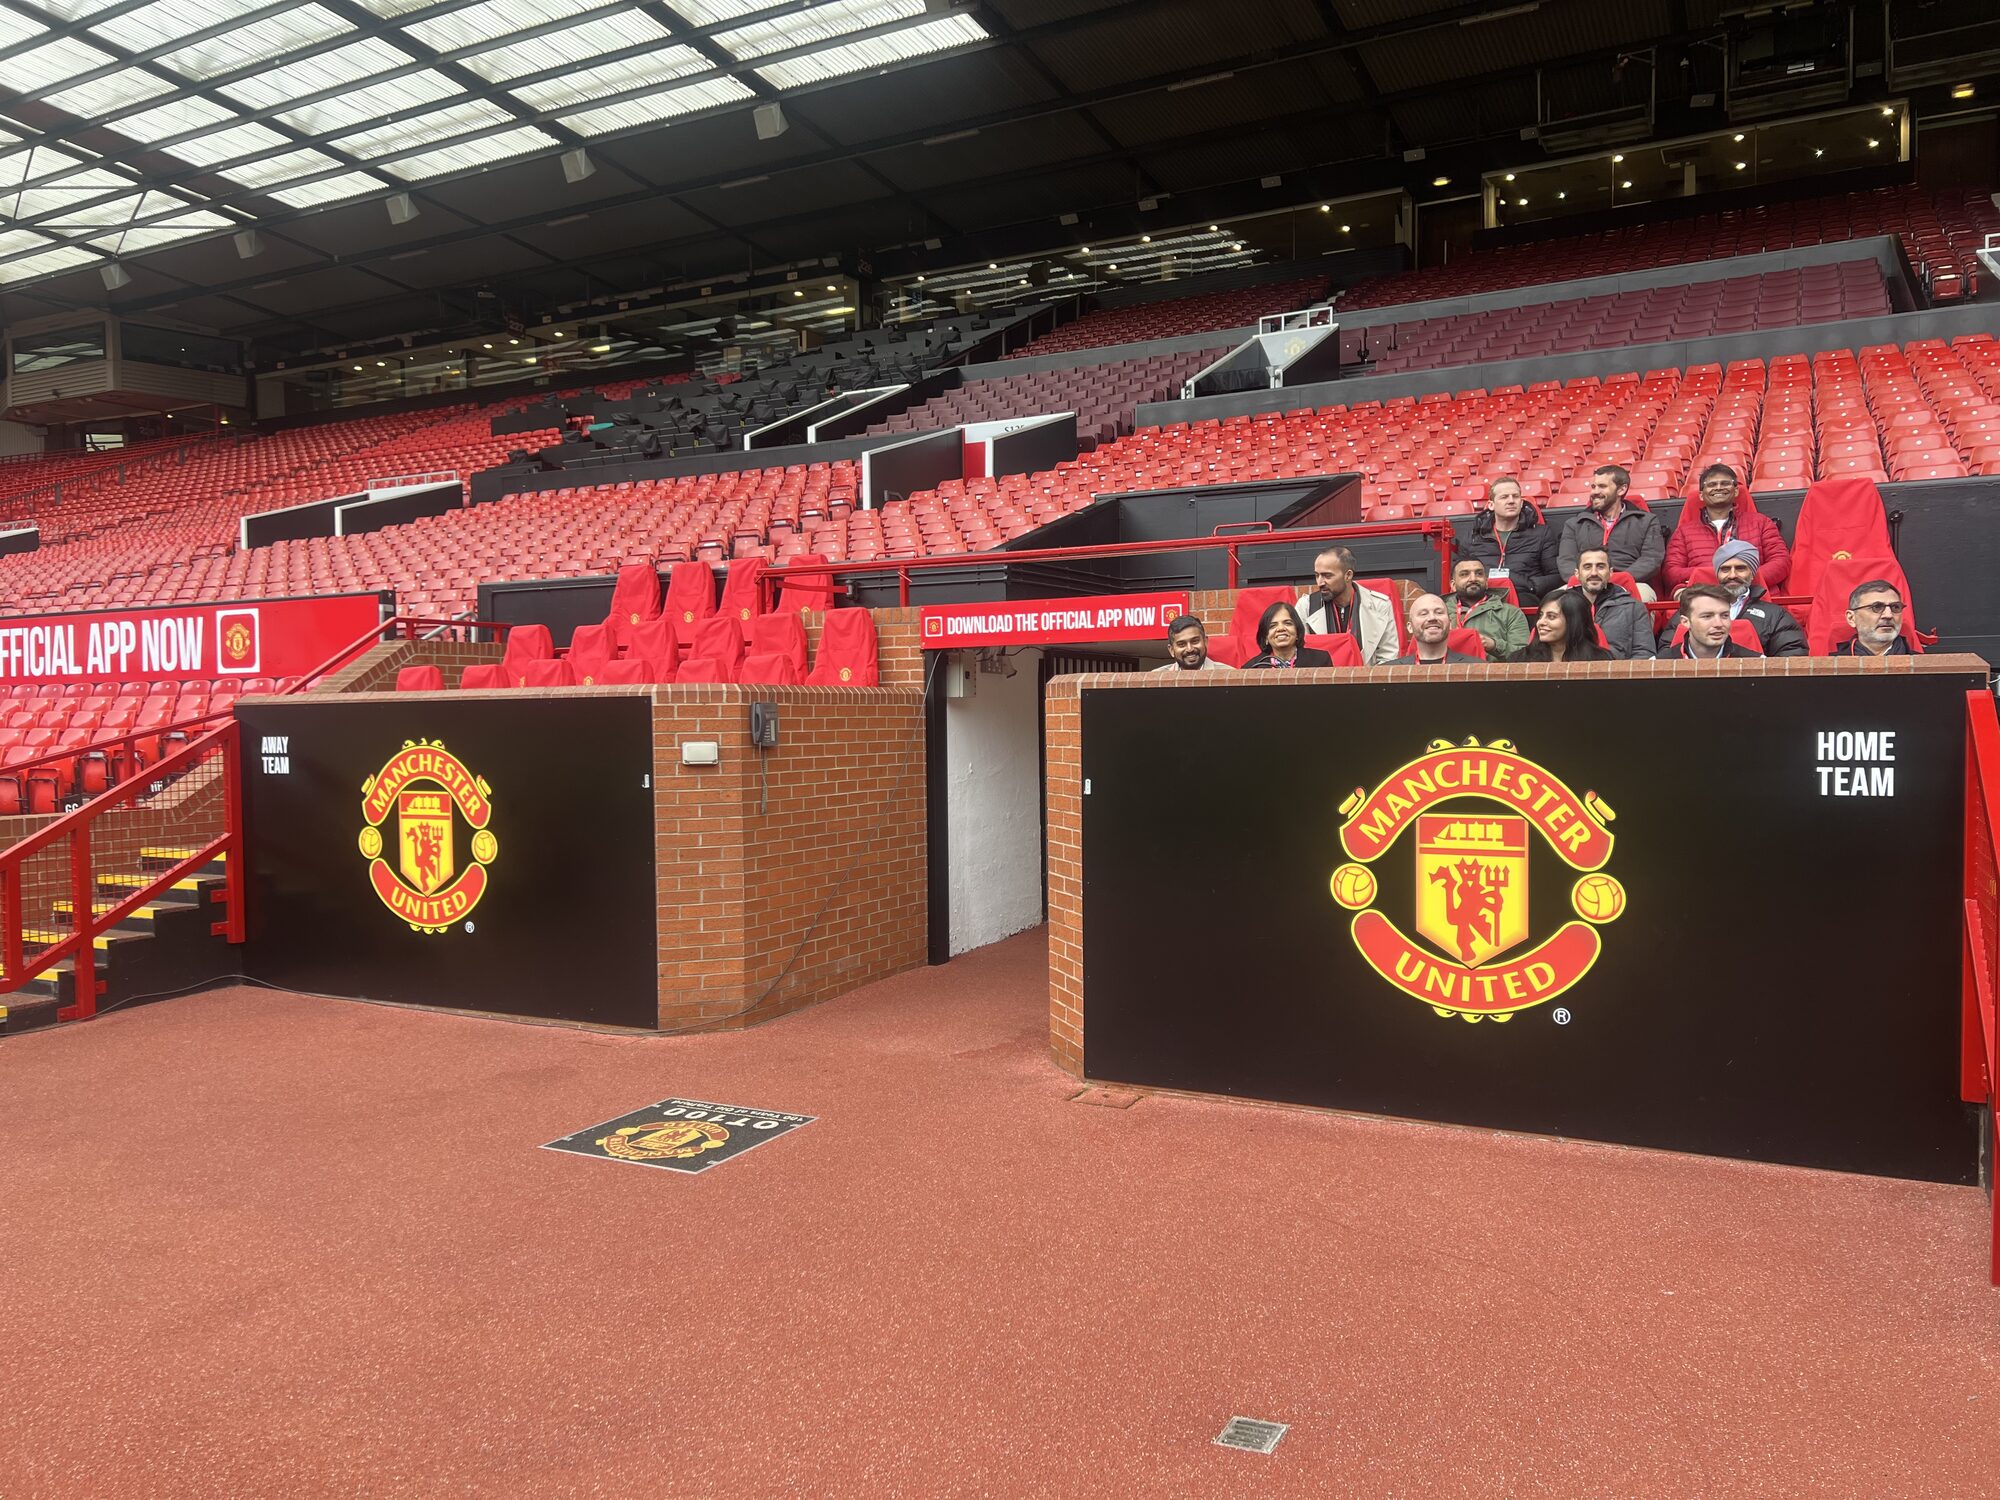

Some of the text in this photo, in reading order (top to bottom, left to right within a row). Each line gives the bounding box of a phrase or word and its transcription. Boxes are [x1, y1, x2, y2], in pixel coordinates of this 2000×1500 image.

[947, 614, 1013, 635] DOWNLOAD
[1014, 613, 1039, 632] THE
[1040, 610, 1095, 631] OFFICIAL
[1096, 608, 1123, 629] APP
[1124, 606, 1156, 627] NOW
[87, 621, 136, 674] APP
[141, 616, 204, 672] NOW
[261, 736, 289, 754] AWAY
[1817, 731, 1896, 761] HOME
[261, 756, 290, 774] TEAM
[371, 753, 481, 817] MANCHESTER
[1816, 766, 1895, 797] TEAM
[1358, 759, 1592, 854] MANCHESTER
[391, 886, 468, 920] UNITED
[1395, 950, 1556, 1002] UNITED
[663, 1107, 780, 1130] OT100
